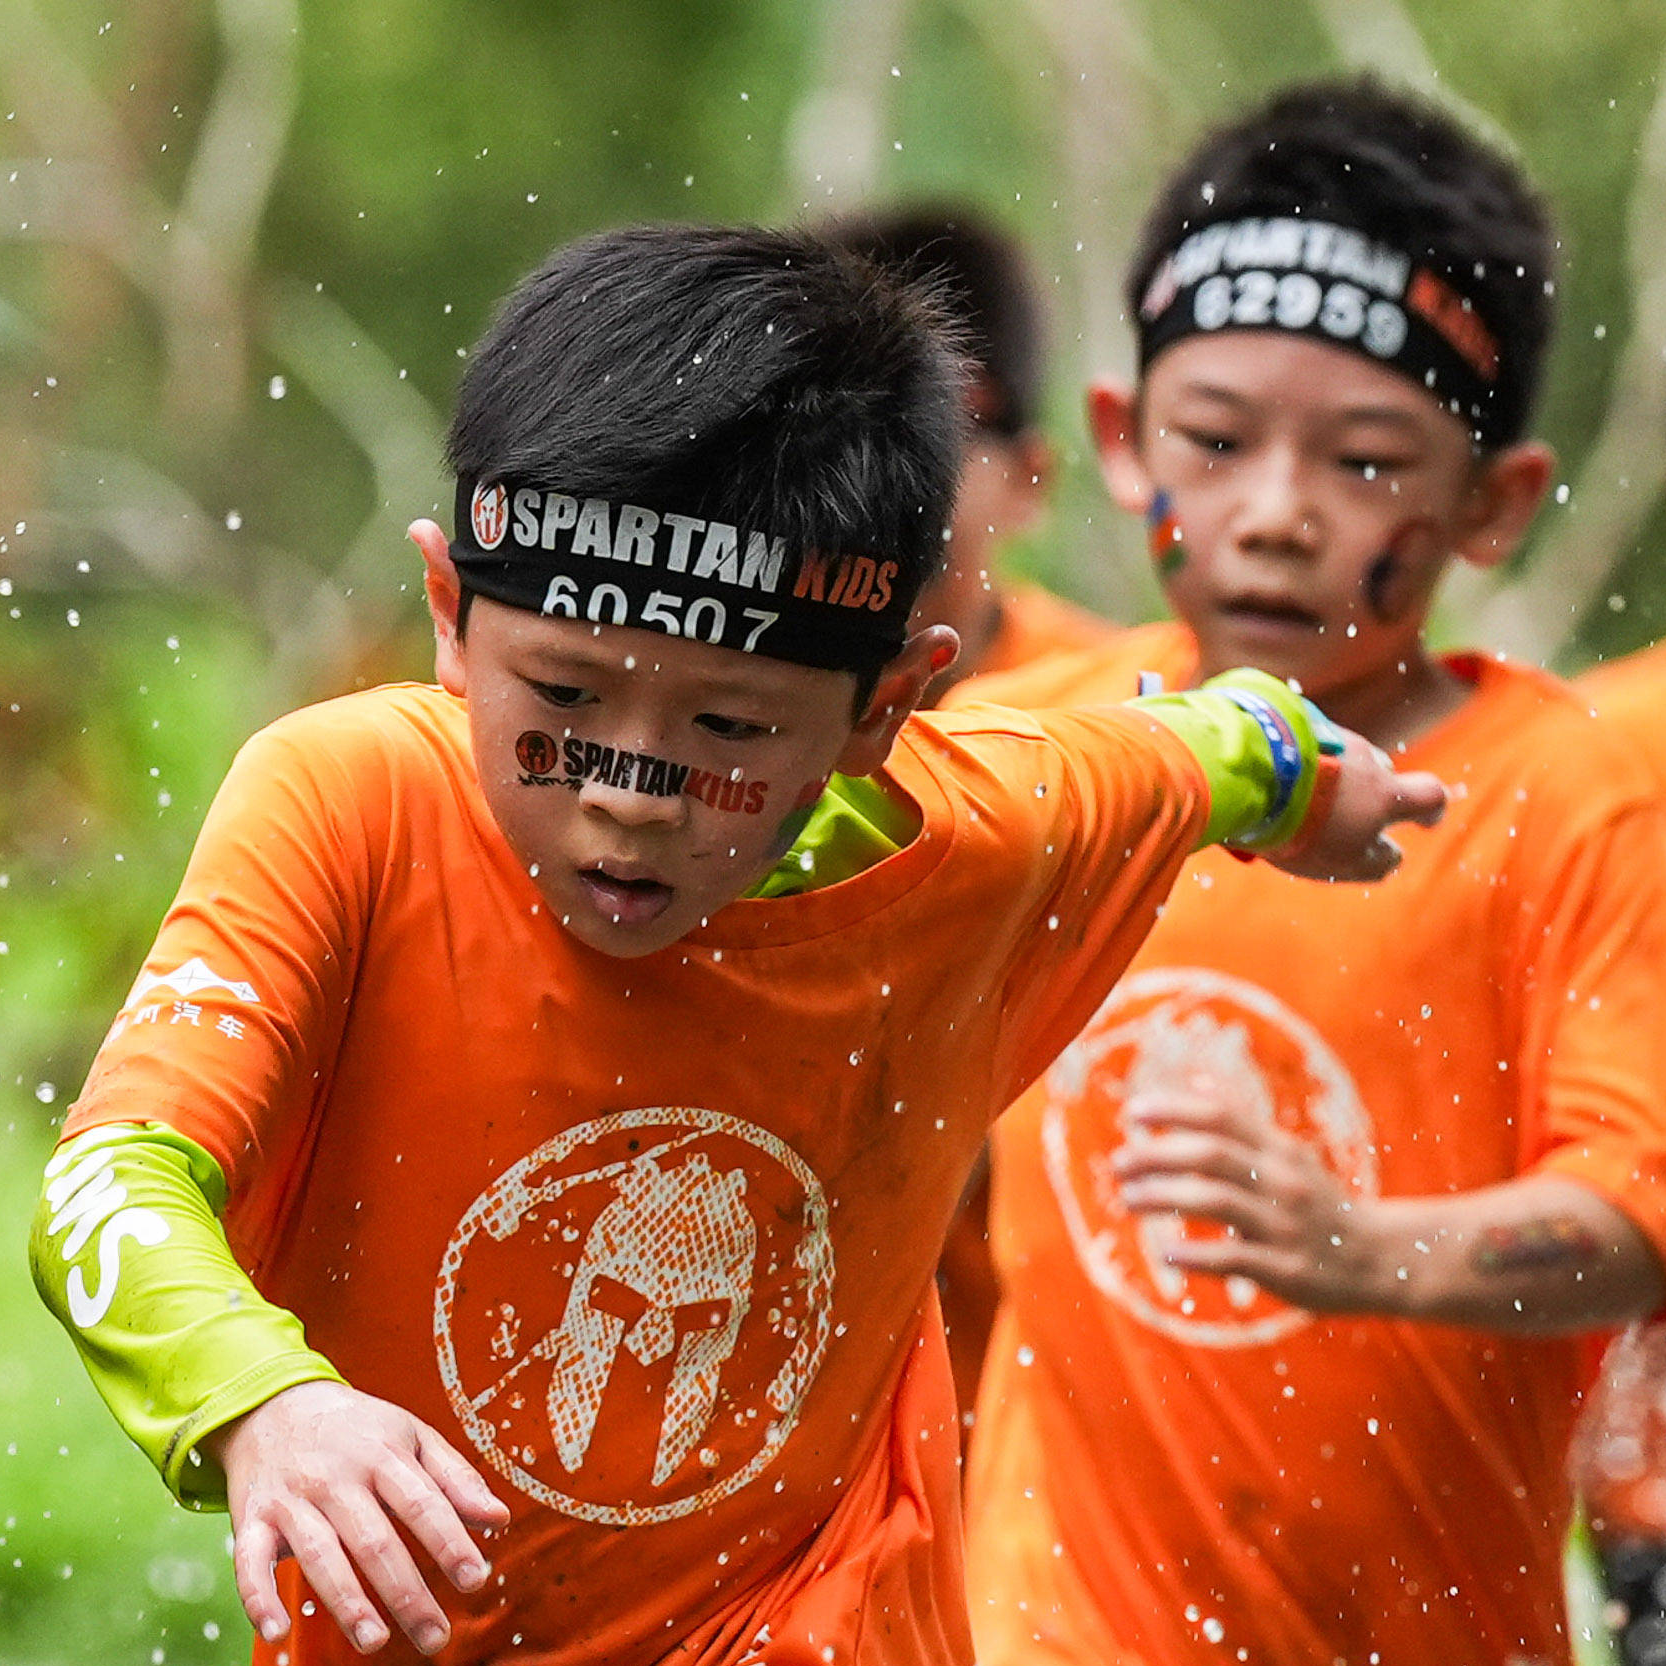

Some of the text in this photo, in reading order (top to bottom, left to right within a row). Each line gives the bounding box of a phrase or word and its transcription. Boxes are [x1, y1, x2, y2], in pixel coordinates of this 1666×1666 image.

[512, 489, 898, 611] SPARTAN KIDS
[542, 575, 780, 652] 60507
